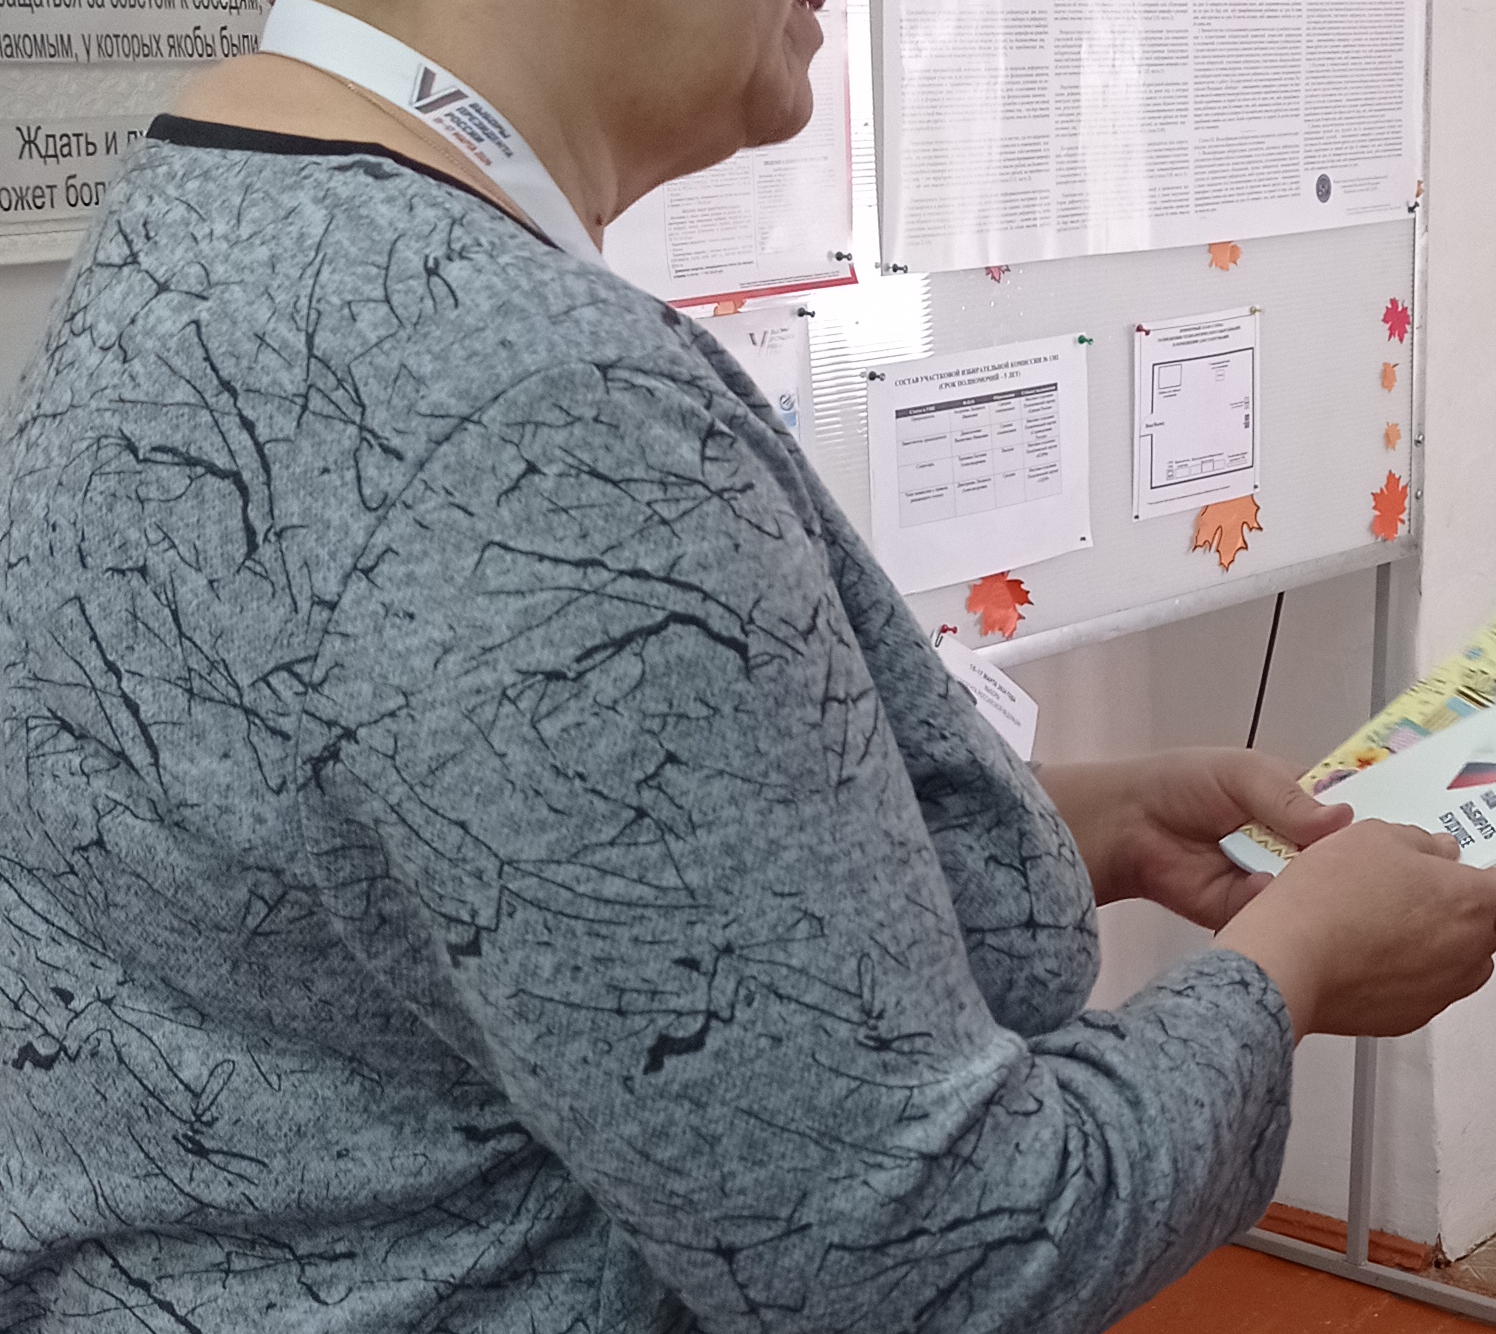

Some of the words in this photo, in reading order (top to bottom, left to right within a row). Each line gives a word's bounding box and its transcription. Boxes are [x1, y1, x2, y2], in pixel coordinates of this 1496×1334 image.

[81, 33, 92, 63] у
[97, 33, 164, 61] которых
[167, 26, 218, 58] якобы
[219, 25, 260, 58] были
[16, 125, 98, 166] Ждать
[105, 131, 118, 156] и
